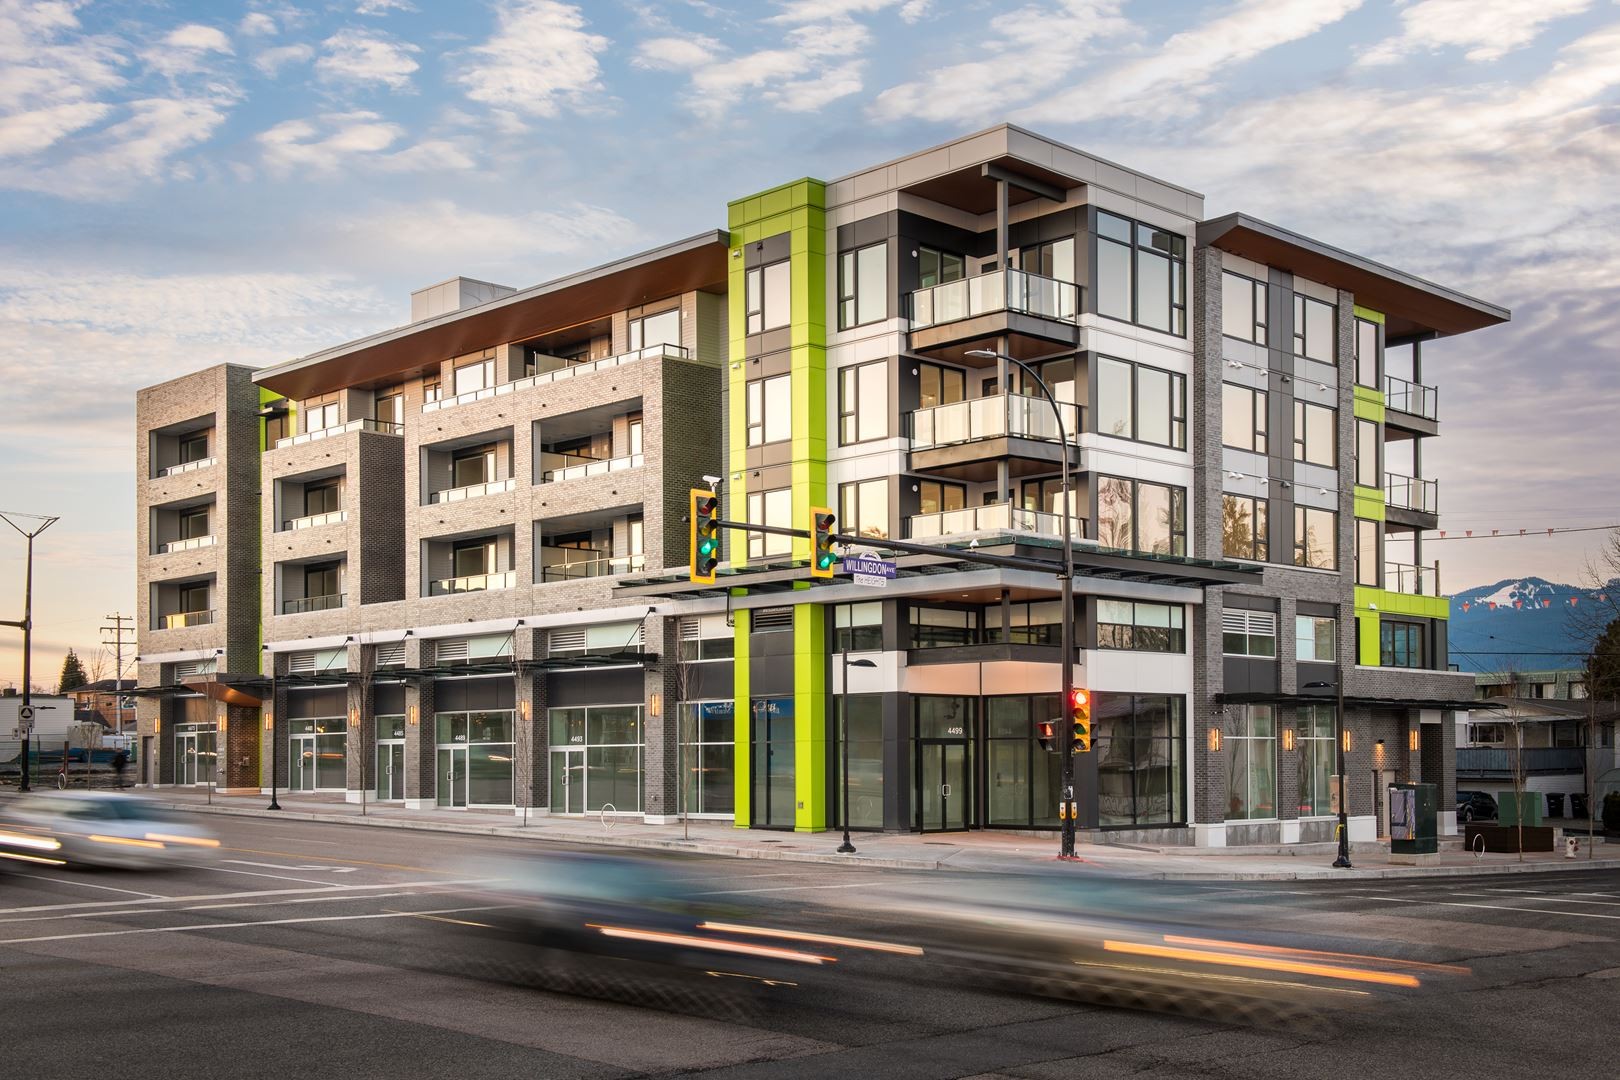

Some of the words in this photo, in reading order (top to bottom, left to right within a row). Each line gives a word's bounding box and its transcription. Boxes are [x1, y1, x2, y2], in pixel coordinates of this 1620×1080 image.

[845, 559, 887, 575] WILLINGDON
[947, 727, 963, 735] 4499
[570, 735, 583, 743] 4493
